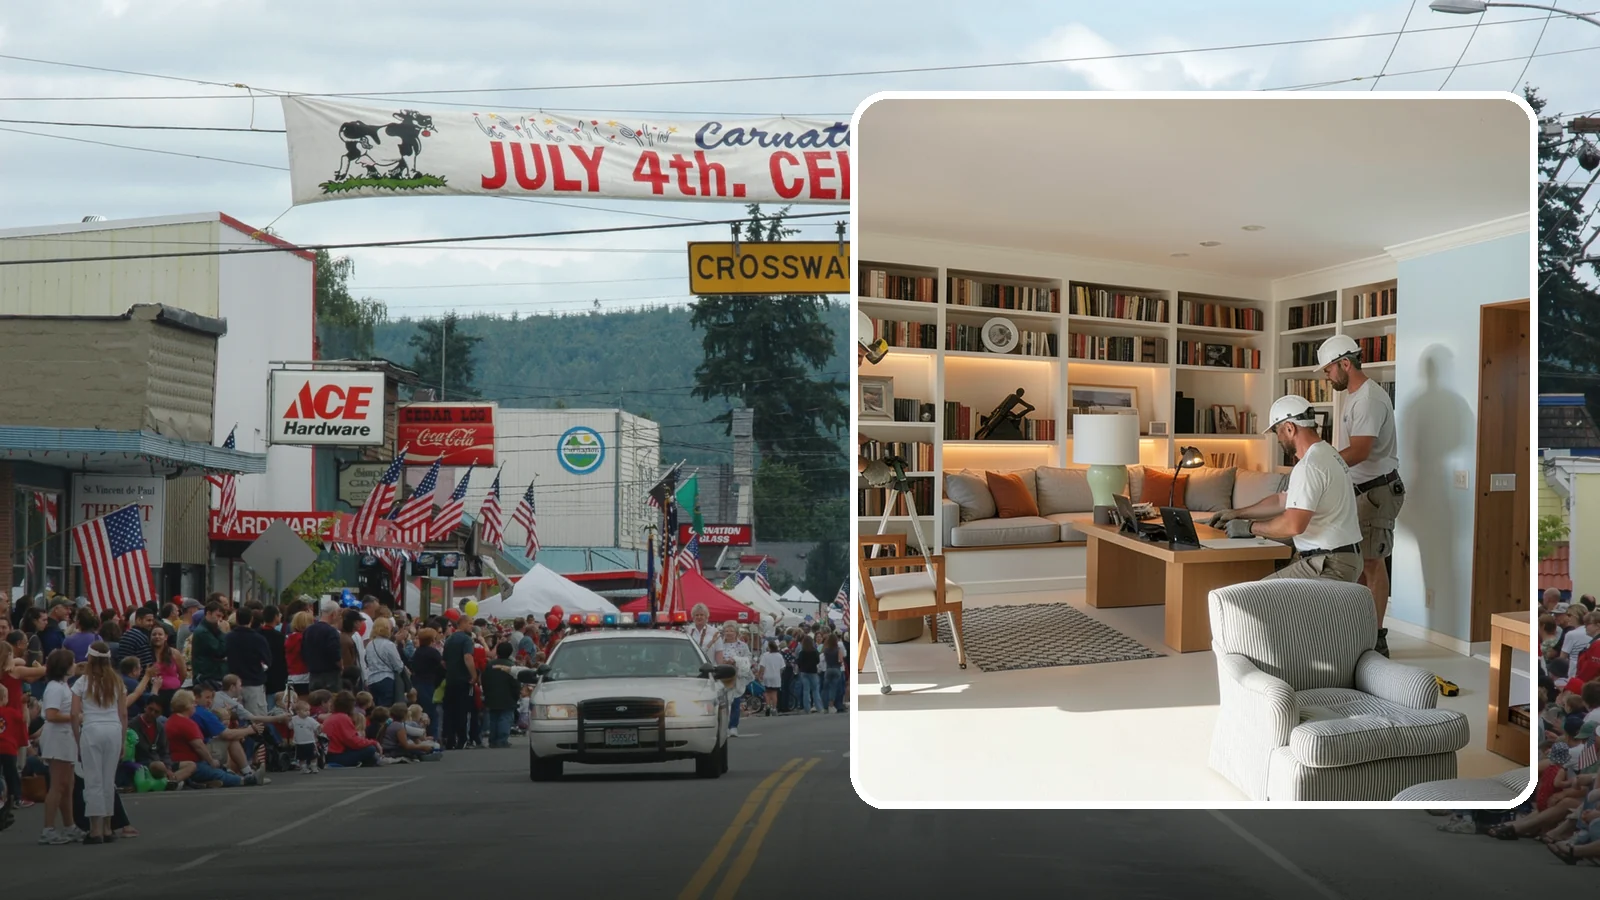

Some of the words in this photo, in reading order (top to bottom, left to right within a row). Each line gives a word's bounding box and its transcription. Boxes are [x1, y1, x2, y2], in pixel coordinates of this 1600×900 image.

[480, 141, 605, 192] JULY
[632, 149, 746, 198] 4th.
[697, 254, 850, 280] CROSSWA
[283, 379, 373, 420] ACE
[406, 409, 453, 421] CEDAR
[461, 409, 486, 421] LOG
[283, 421, 371, 436] Hardware
[416, 428, 477, 447] Coca-Cola
[96, 485, 124, 495] Vincent
[126, 486, 135, 494] de
[137, 486, 155, 495] Paul
[688, 526, 741, 535] CRNATION
[699, 535, 730, 544] GLASS
